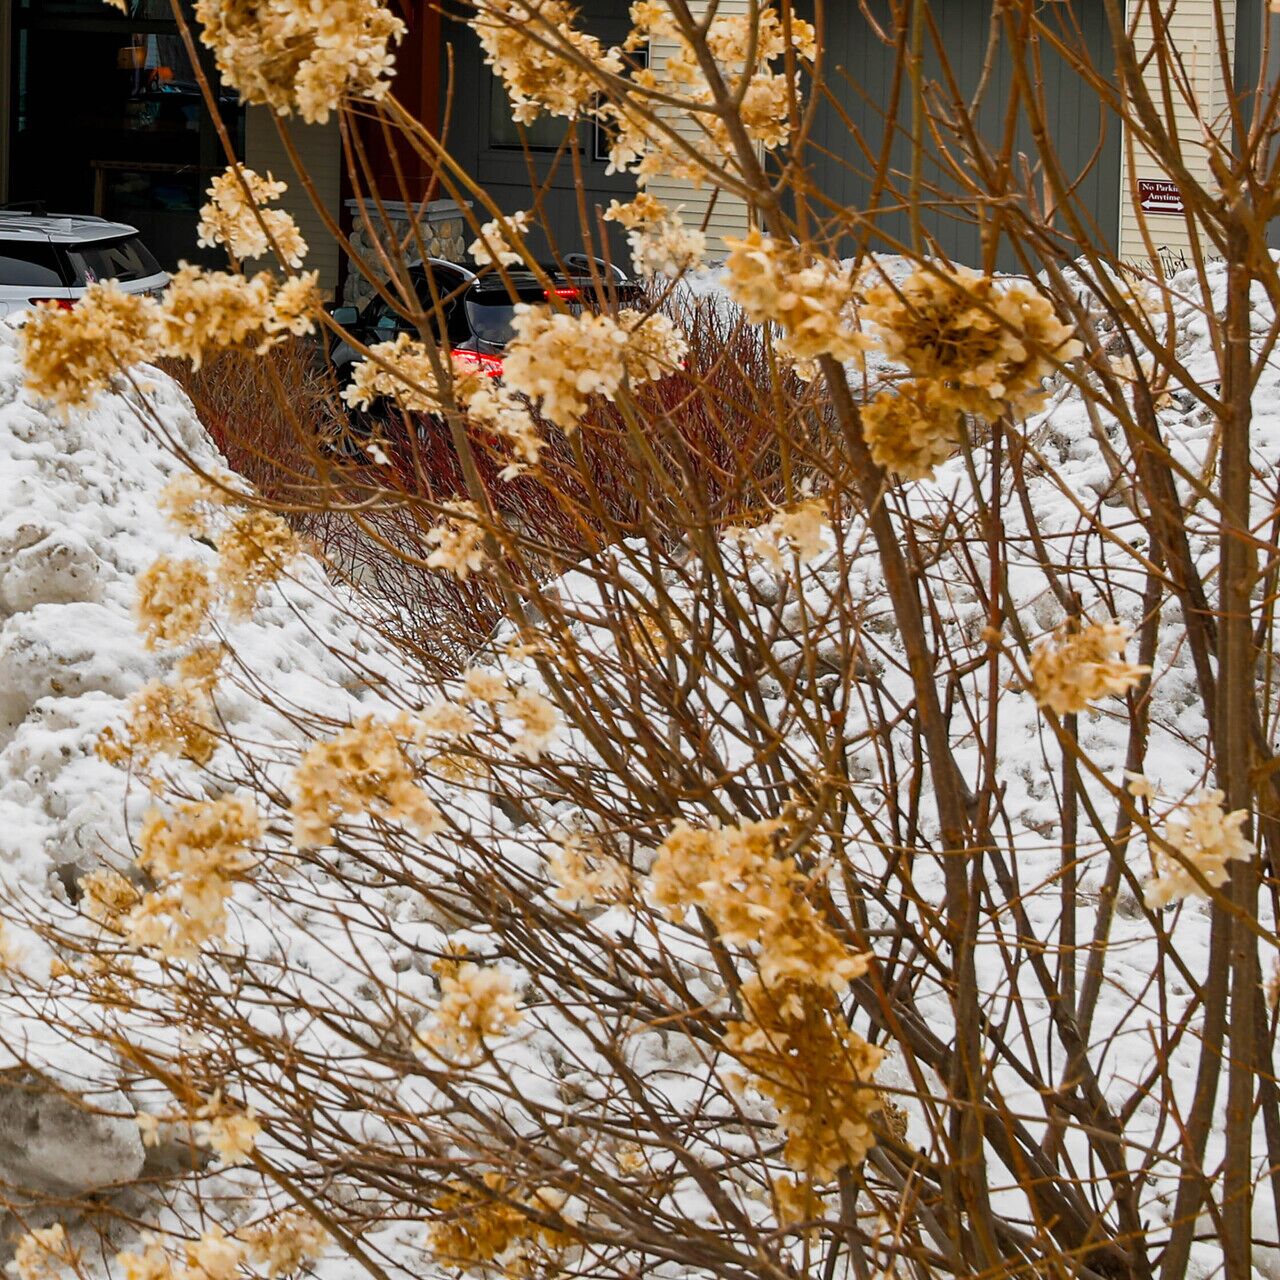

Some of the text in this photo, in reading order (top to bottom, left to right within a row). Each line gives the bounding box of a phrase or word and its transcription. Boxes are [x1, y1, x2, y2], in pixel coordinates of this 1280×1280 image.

[1142, 183, 1178, 192] No Parkin
[1148, 192, 1181, 201] Anytime
